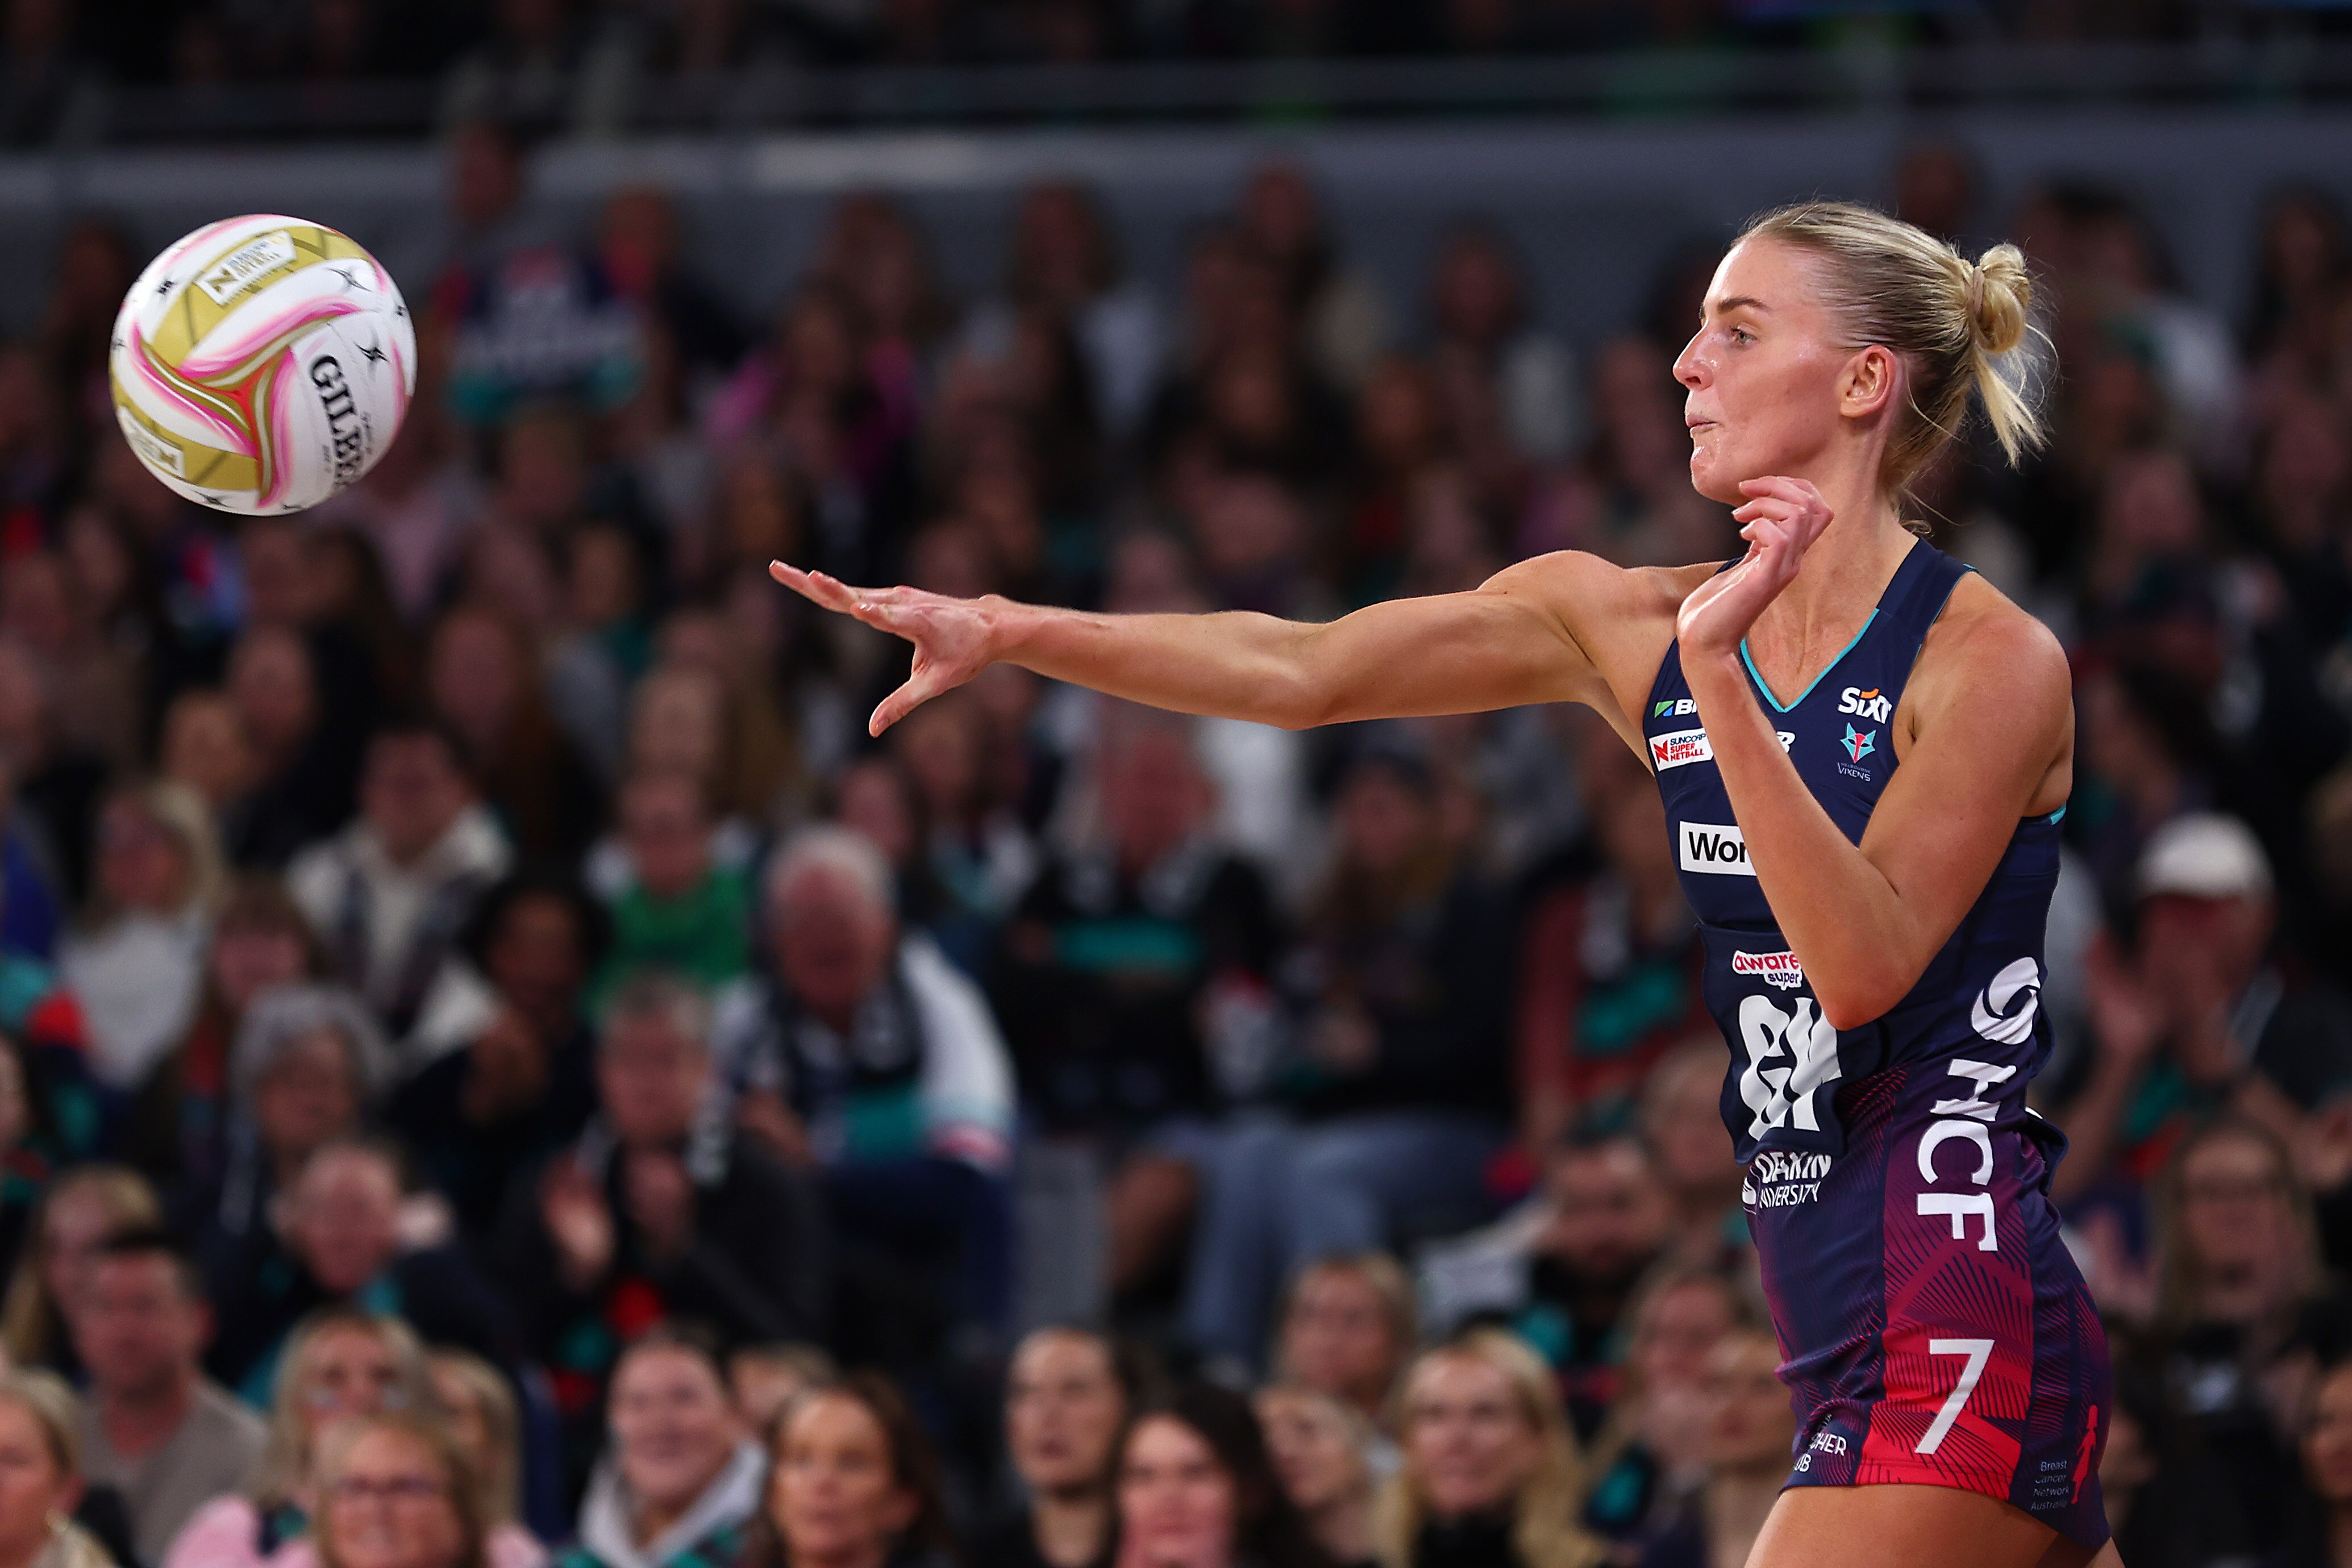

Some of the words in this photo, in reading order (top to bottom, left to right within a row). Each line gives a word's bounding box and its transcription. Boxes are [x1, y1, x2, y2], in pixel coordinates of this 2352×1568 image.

[1670, 733, 1706, 745] SUNCORP
[1671, 743, 1696, 753] SUPER
[1671, 748, 1704, 761] NETBALL
[1838, 762, 1871, 782] VIXENS
[1841, 762, 1871, 774] MELBOURNE
[1688, 831, 1746, 863] Wor
[1735, 954, 1799, 971] aware
[1768, 972, 1800, 986] super
[1916, 1058, 2017, 1251] HCF
[1760, 1181, 1821, 1209] NIVERSITY
[1914, 1338, 1995, 1455] 7
[1809, 1432, 1847, 1456] CHER
[2041, 1460, 2067, 1471] Breast
[2033, 1486, 2070, 1496] Network
